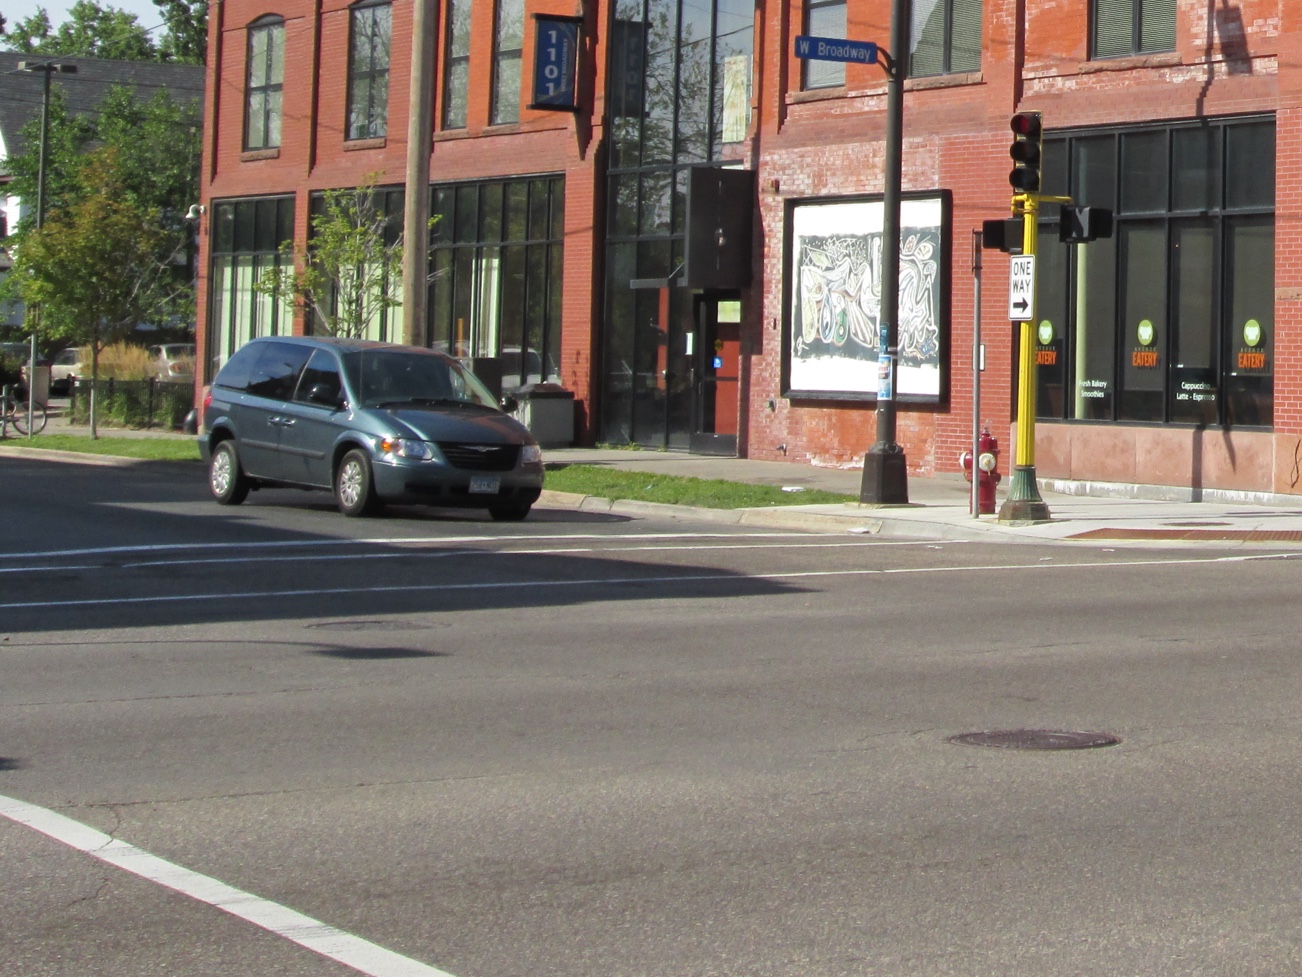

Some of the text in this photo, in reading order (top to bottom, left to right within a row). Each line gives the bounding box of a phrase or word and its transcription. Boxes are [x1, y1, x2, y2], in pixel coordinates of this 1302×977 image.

[800, 40, 870, 62] W Broadway
[544, 30, 558, 96] 1101
[1013, 261, 1031, 276] ONE
[1012, 279, 1031, 293] WAY
[1132, 351, 1158, 366] EATERY
[1238, 352, 1265, 368] EATERY
[1091, 380, 1107, 389] Bakery
[1080, 390, 1105, 398] Smoothies
[1176, 392, 1189, 400] Latte
